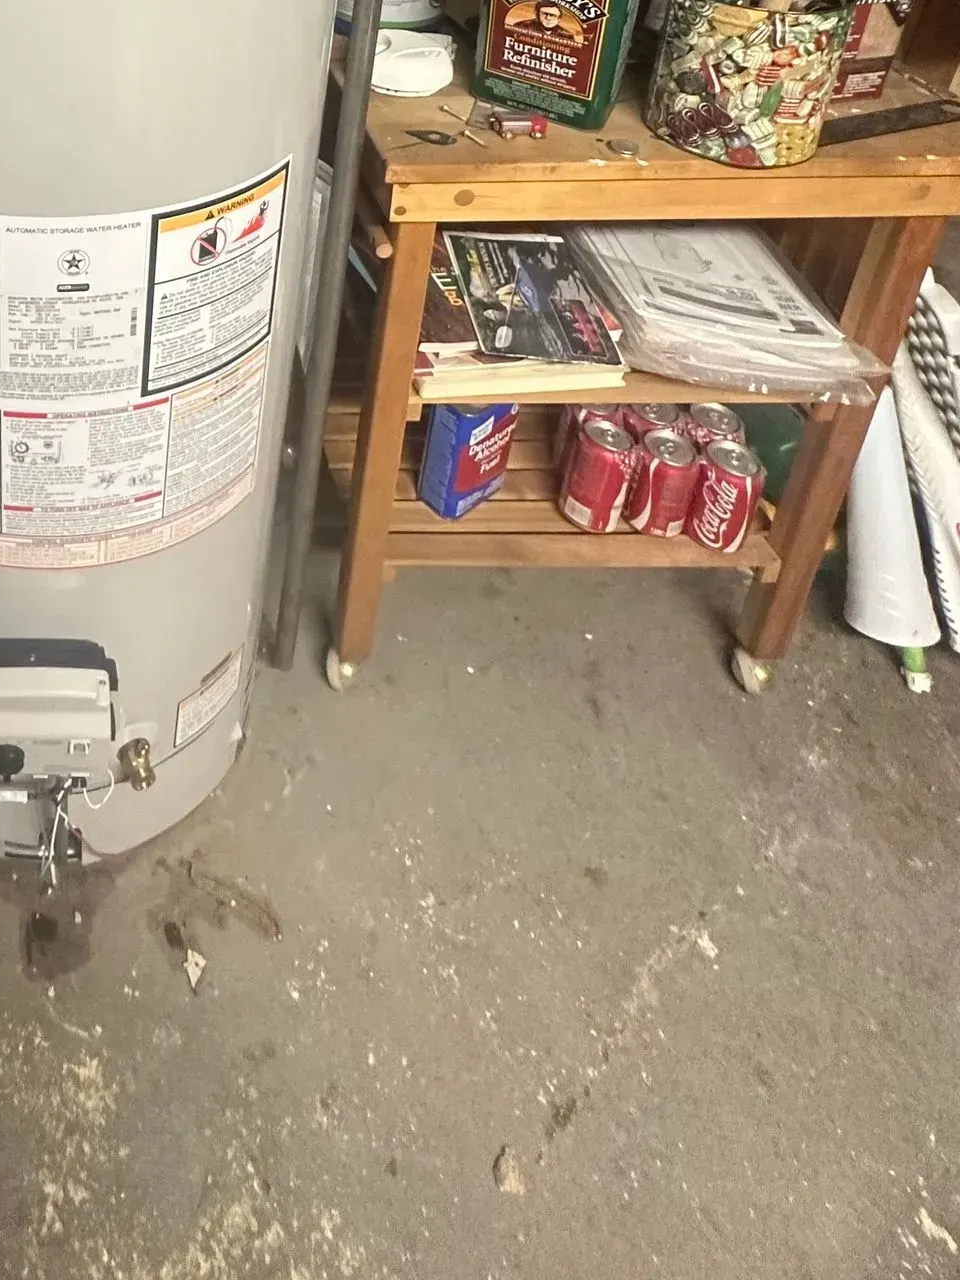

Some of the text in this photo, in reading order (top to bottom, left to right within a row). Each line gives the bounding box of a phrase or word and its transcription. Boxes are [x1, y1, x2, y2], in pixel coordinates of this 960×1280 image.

[504, 36, 578, 66] Furniture
[514, 34, 570, 54] Conditioning
[503, 48, 576, 78] Refinisher
[216, 194, 254, 216] WARNING
[6, 226, 48, 234] AUTOMATIC
[114, 222, 141, 230] HEATER
[475, 431, 510, 462] Alcohol
[480, 454, 500, 474] Fuel
[694, 467, 739, 548] Coca-Cola
